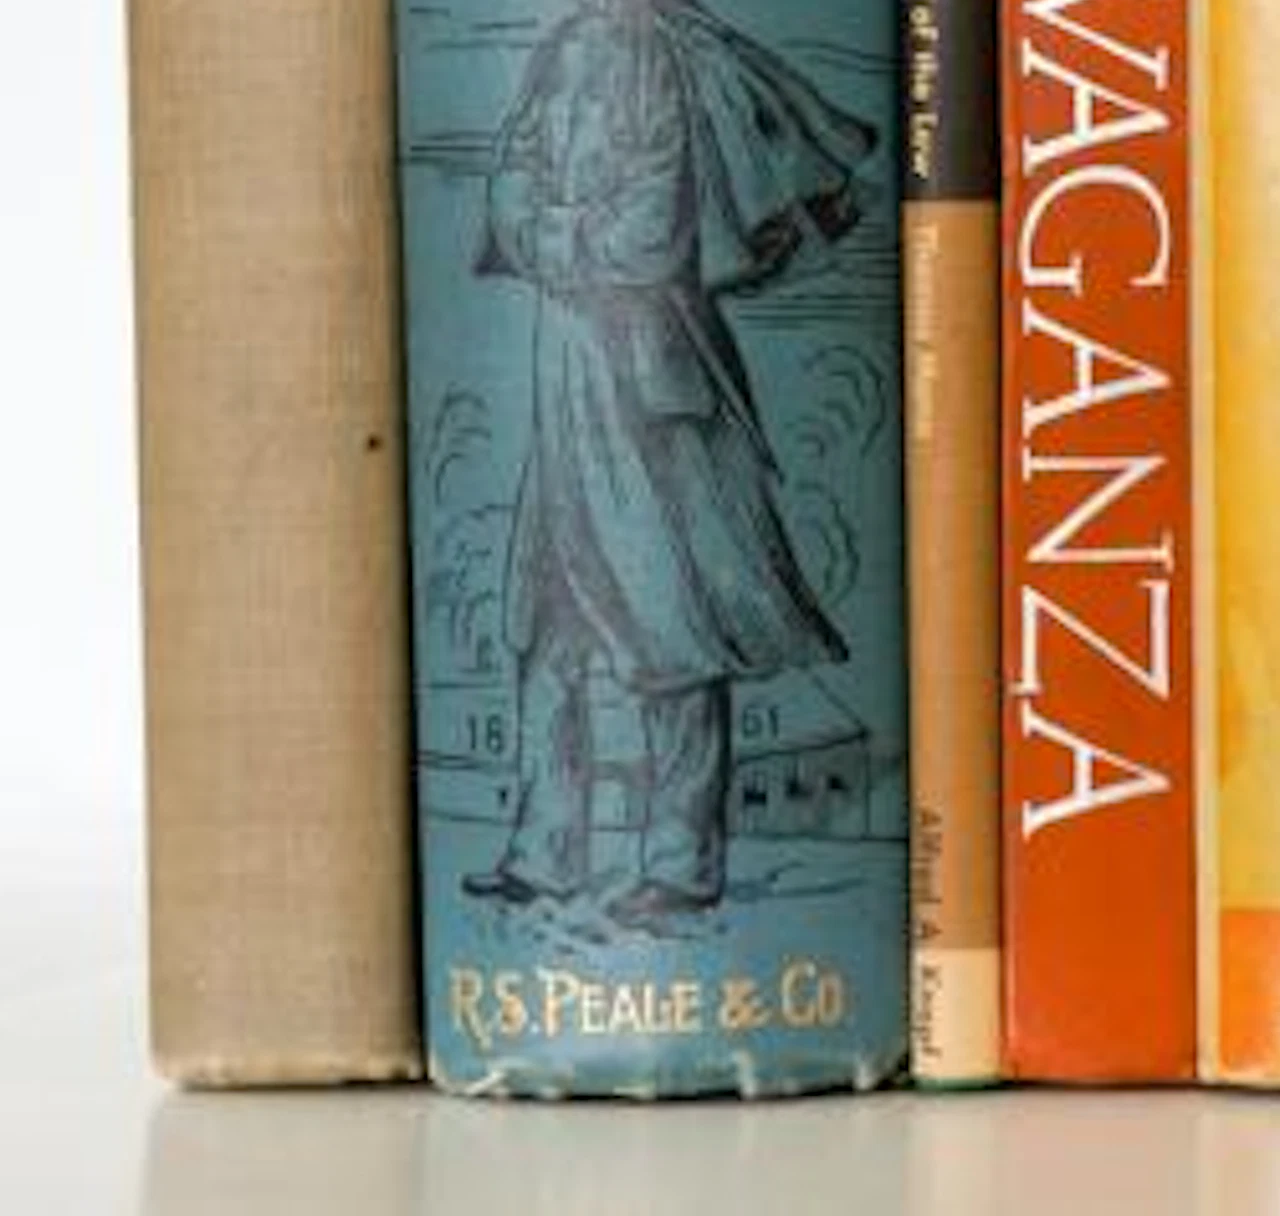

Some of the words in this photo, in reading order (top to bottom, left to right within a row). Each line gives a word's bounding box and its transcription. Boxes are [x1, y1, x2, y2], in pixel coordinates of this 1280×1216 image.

[907, 5, 940, 40] of
[907, 50, 940, 102] the
[907, 111, 940, 180] Law
[721, 975, 771, 1032] &
